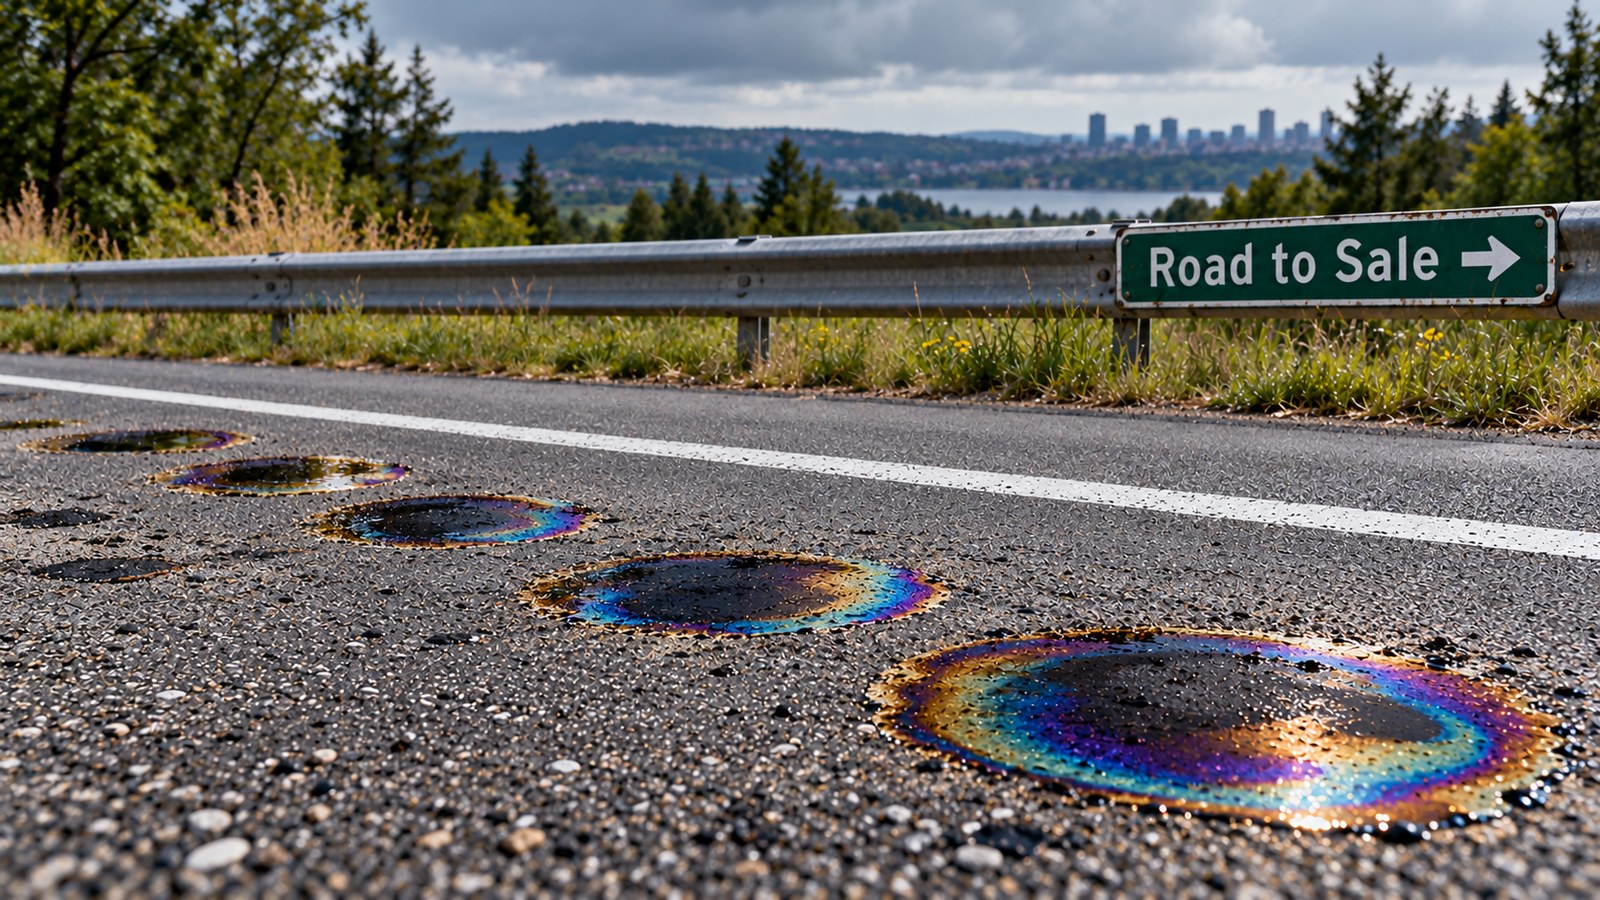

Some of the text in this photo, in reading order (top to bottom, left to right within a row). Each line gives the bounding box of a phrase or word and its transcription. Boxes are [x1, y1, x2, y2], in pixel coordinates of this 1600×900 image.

[1150, 236, 1439, 287] Road to Sale
